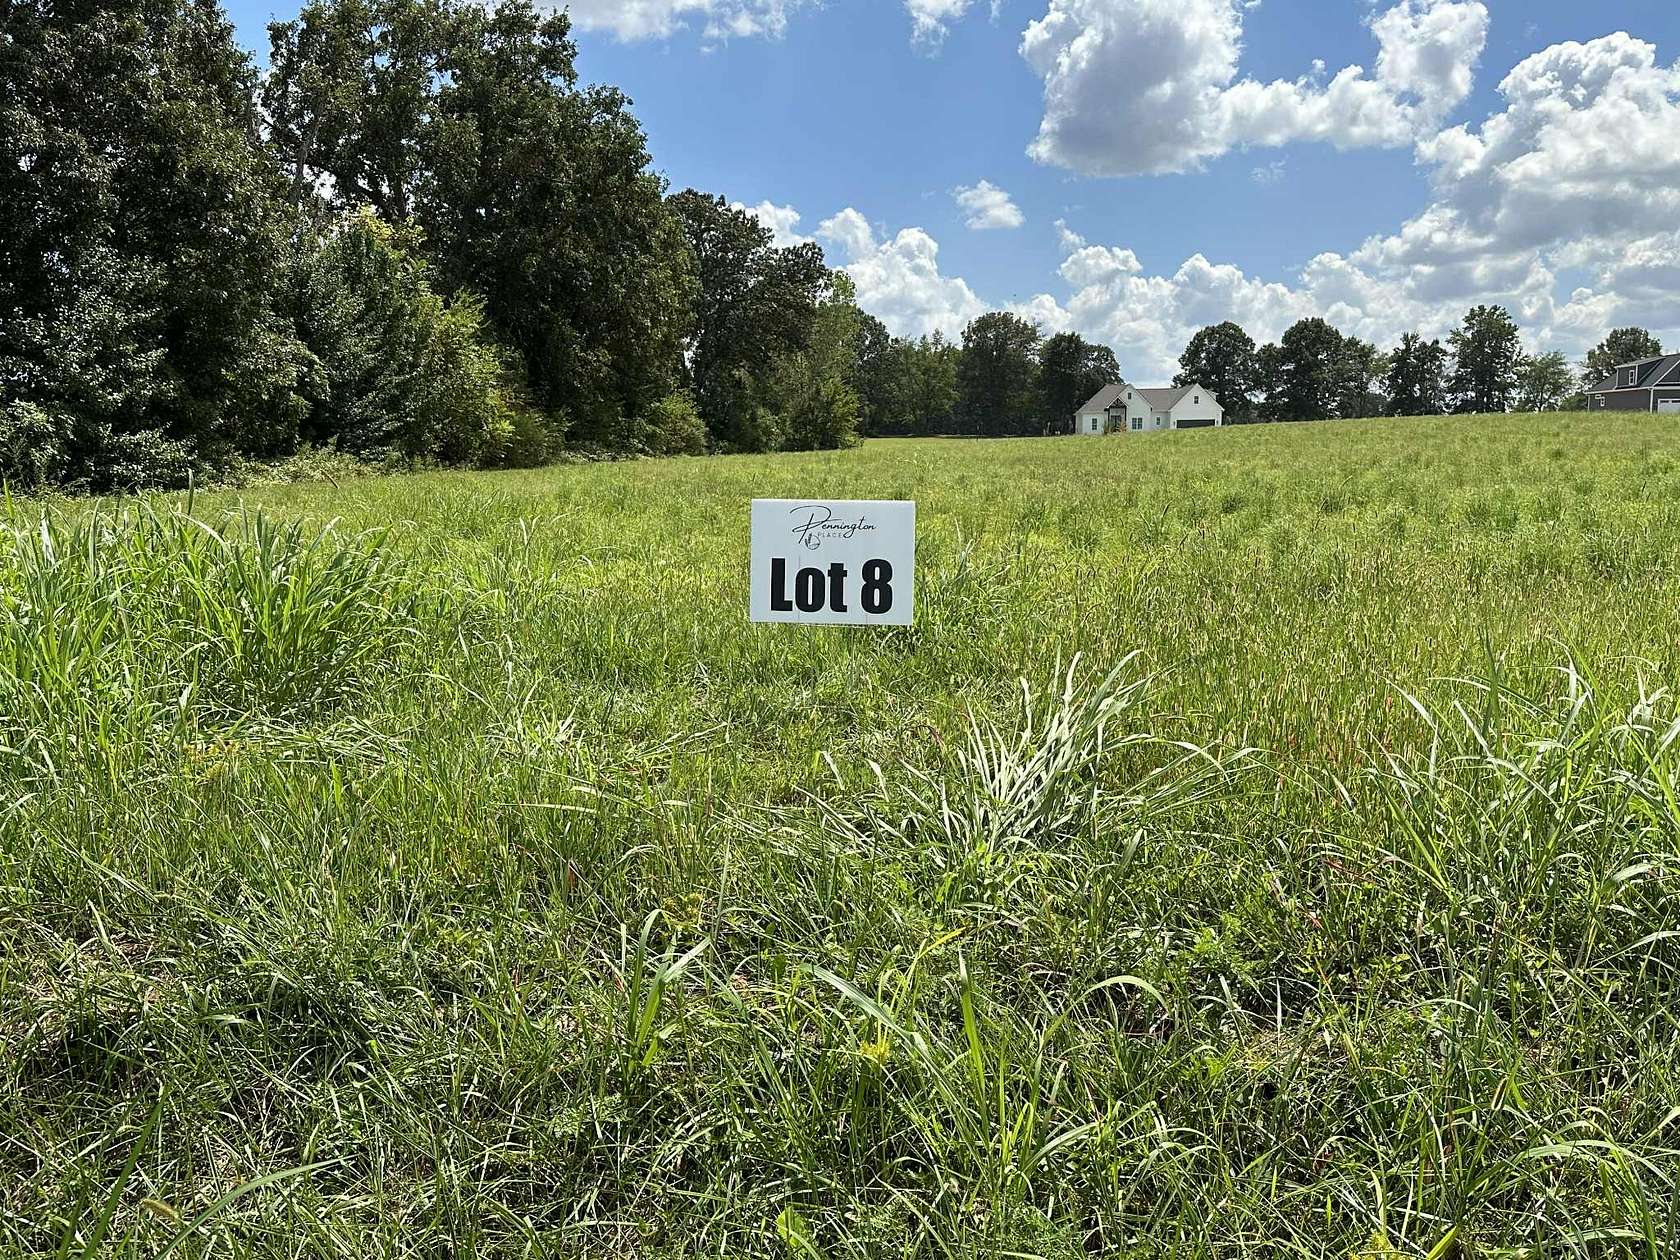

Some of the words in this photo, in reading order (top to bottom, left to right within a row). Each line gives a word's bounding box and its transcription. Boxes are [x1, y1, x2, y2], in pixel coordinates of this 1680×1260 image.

[789, 505, 877, 544] Pennington
[770, 557, 848, 613] Lot
[860, 558, 893, 614] 8
